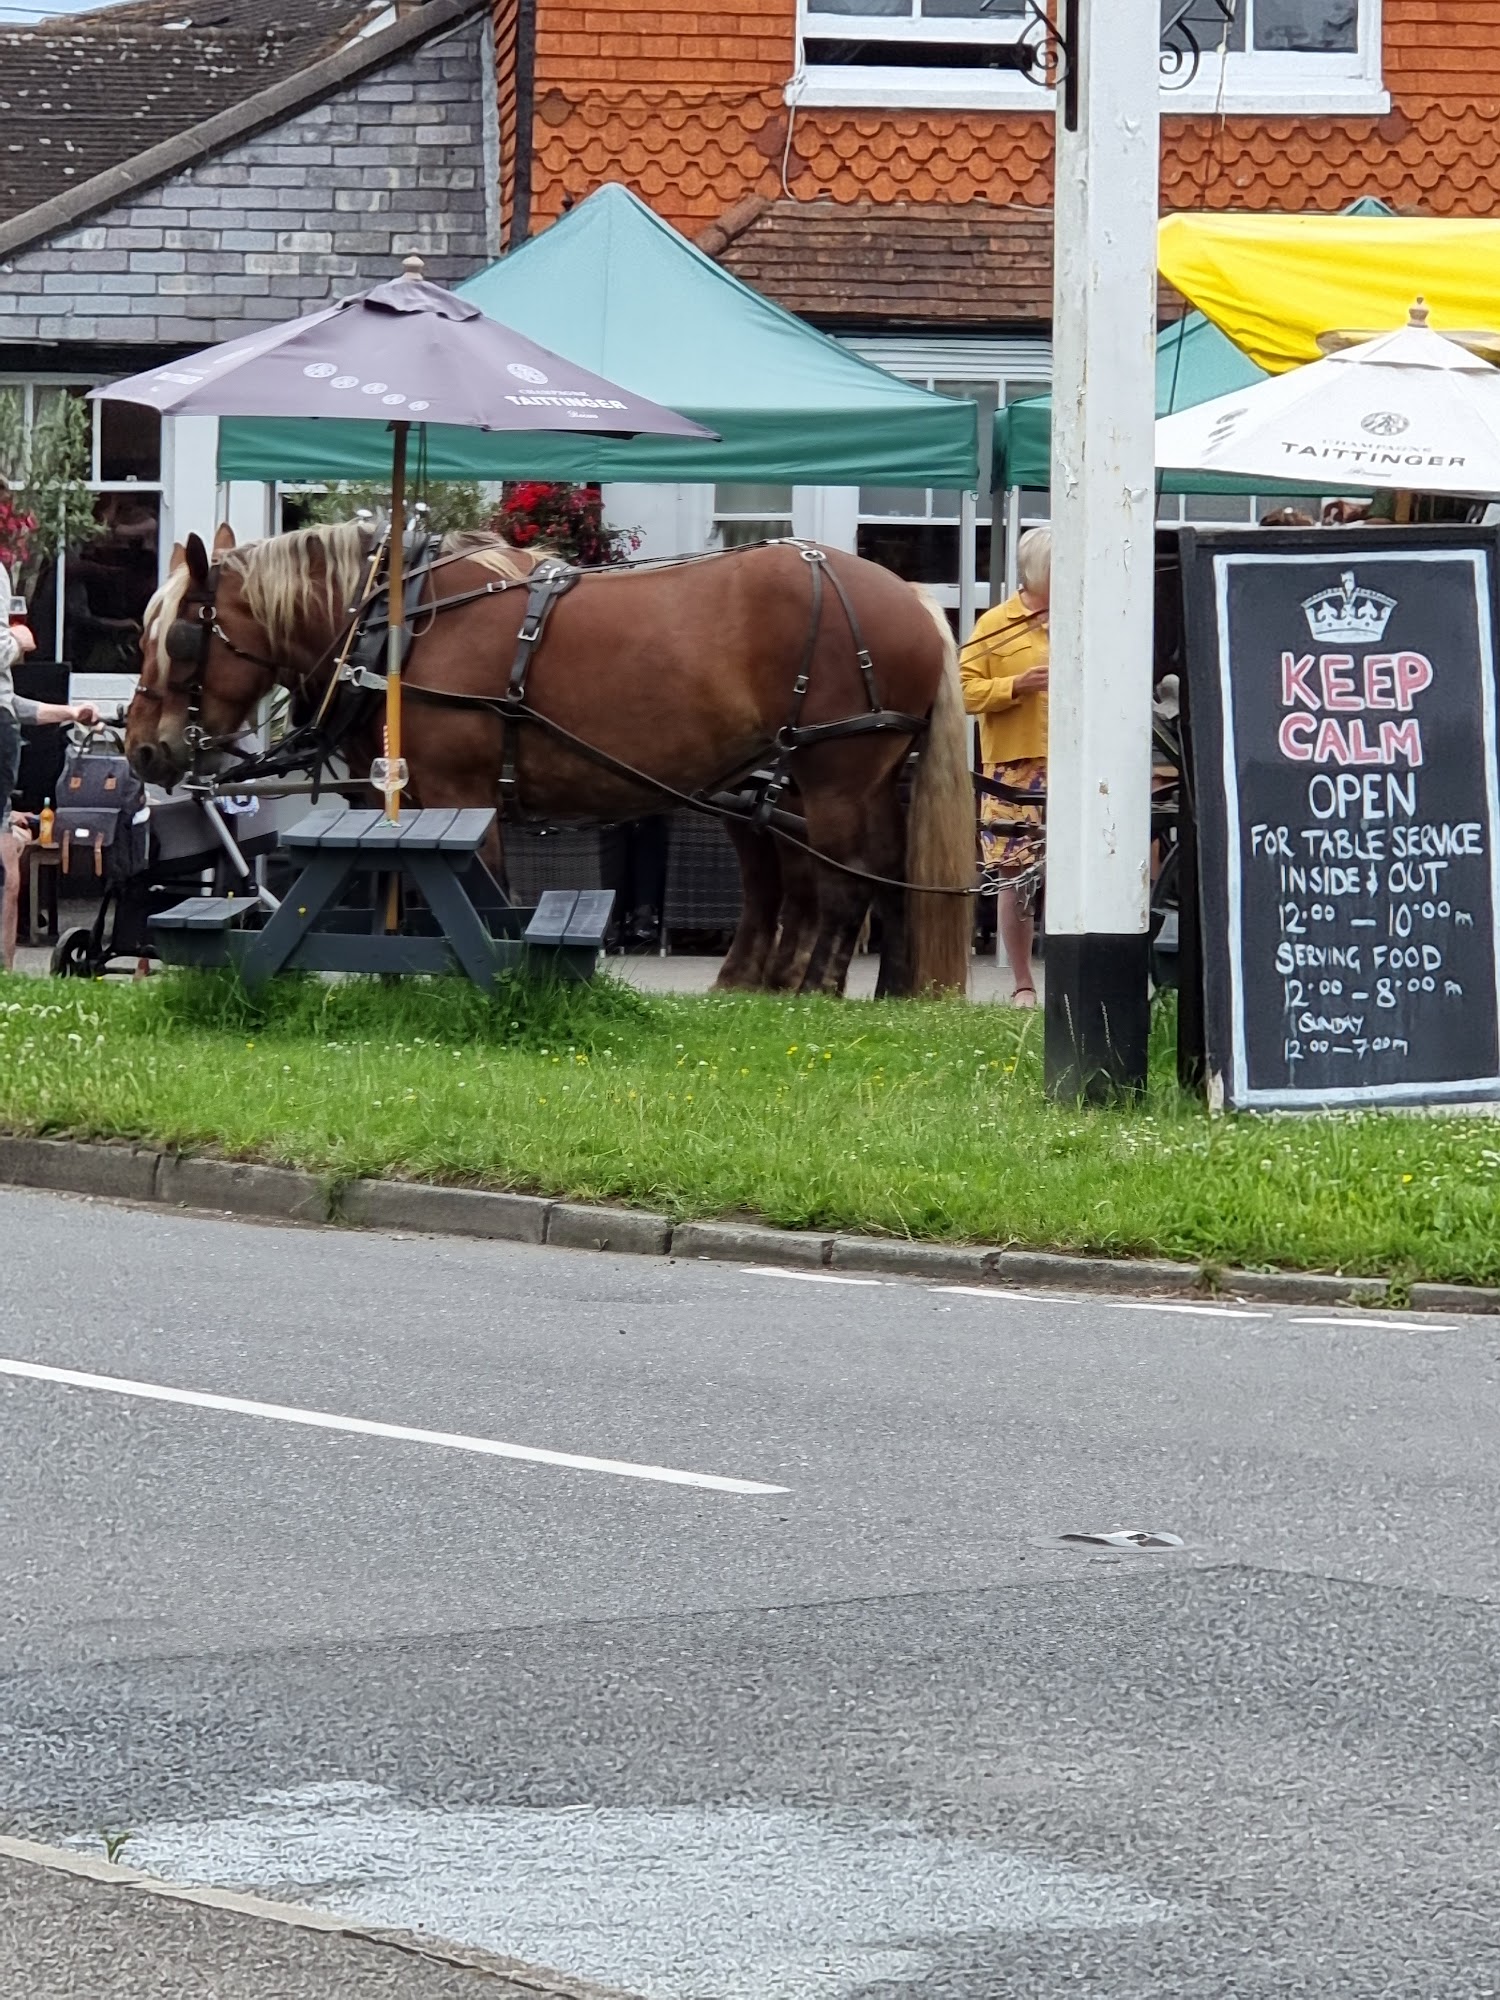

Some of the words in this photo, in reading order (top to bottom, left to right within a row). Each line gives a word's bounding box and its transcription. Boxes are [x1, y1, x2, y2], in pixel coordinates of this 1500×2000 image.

[503, 395, 629, 410] TAITTINGER
[1281, 441, 1466, 467] TAITTINGER
[1281, 651, 1433, 711] KEEP
[1278, 712, 1423, 767] CALM
[1308, 772, 1416, 820] OPEN
[1251, 824, 1295, 857] FOR
[1301, 829, 1385, 860] TABLE
[1392, 823, 1483, 857] SERVICE
[1281, 864, 1361, 896] INSIDE
[1388, 862, 1448, 895] OUT
[1275, 941, 1361, 974] SERVING
[1373, 945, 1441, 971] FOOD
